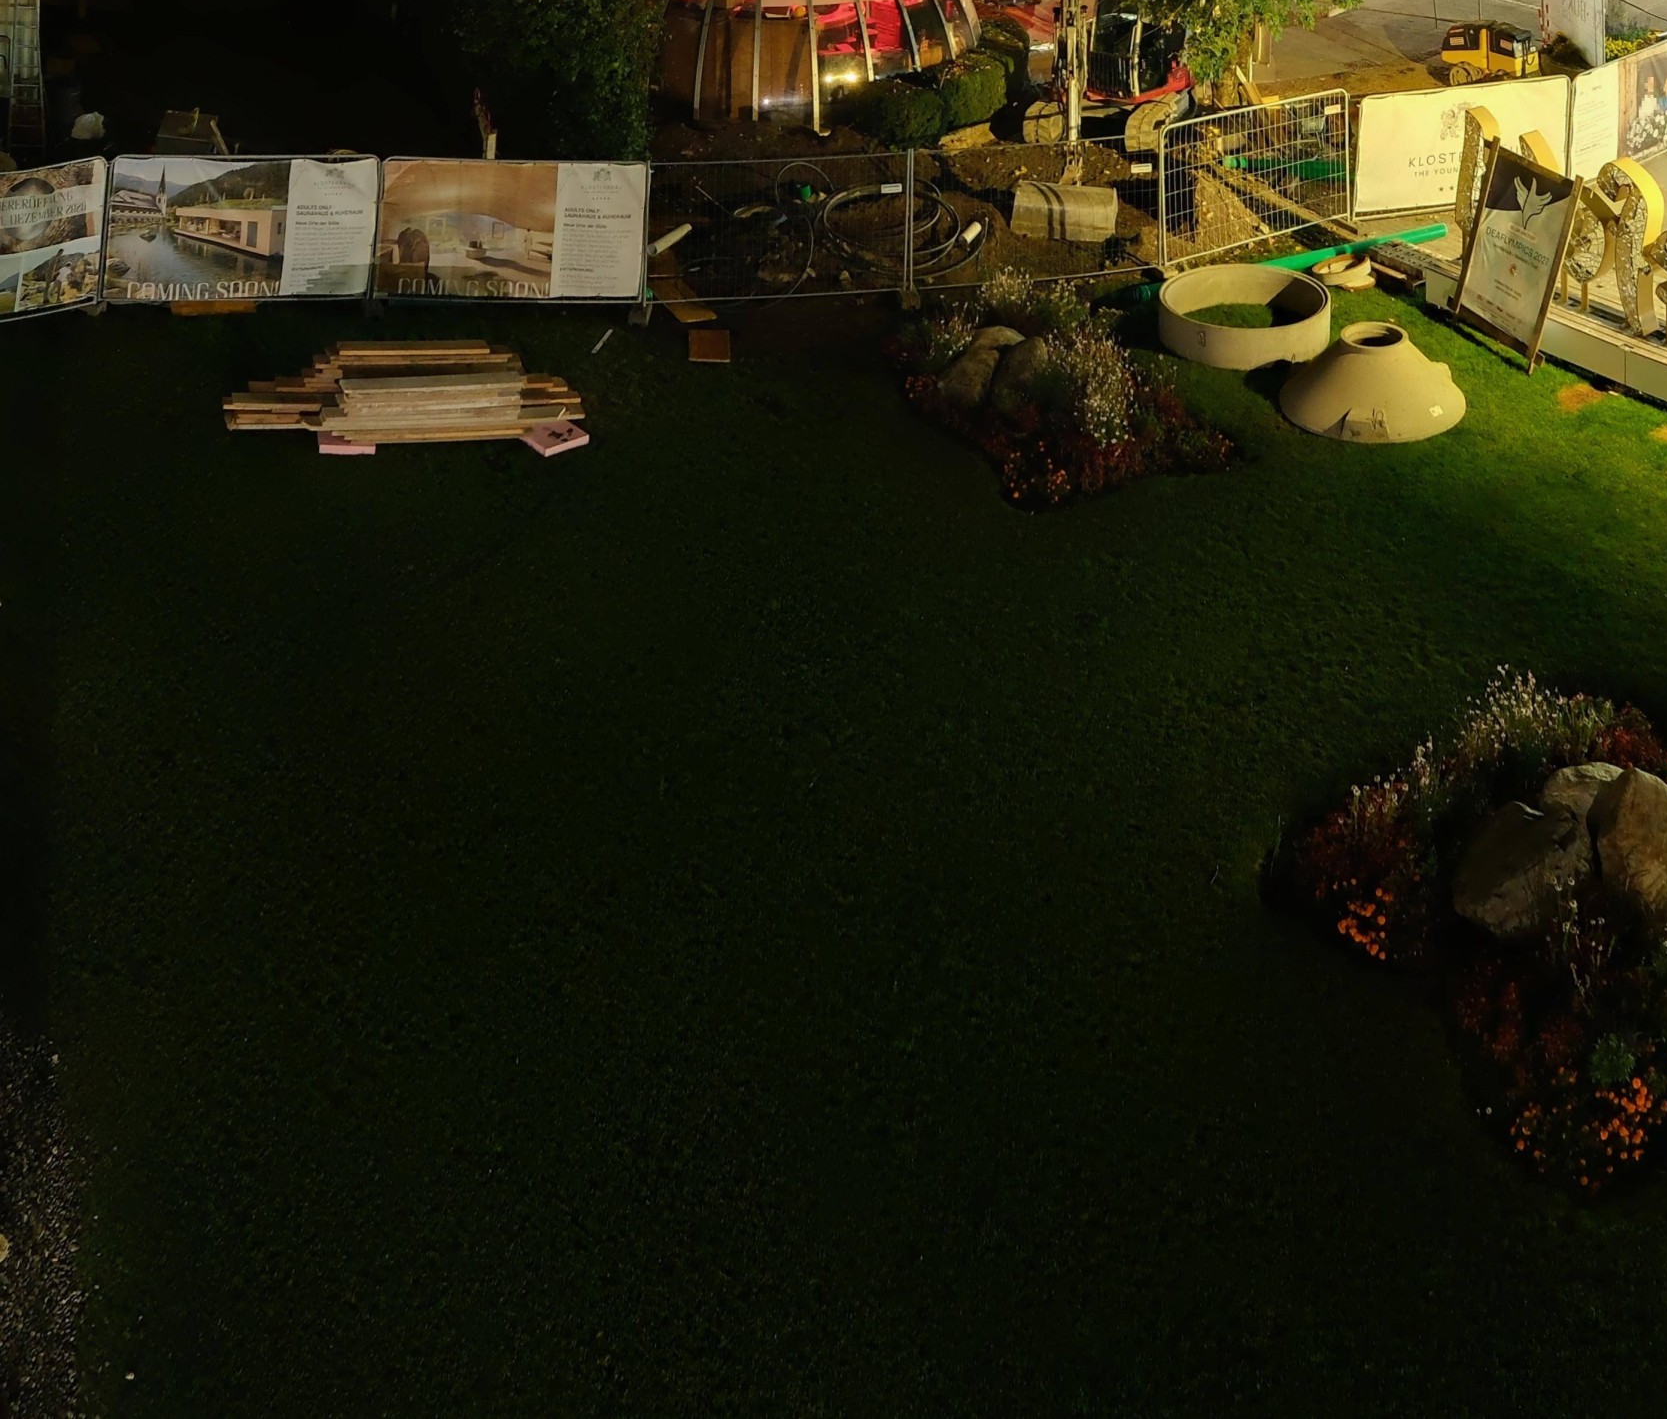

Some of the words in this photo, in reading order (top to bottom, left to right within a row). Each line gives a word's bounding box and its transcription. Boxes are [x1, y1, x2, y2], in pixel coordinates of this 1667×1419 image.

[1434, 167, 1459, 176] YOUN
[0, 190, 73, 212] ERERÖFFNUNG
[1486, 226, 1533, 258] DEAFLYMPICS
[1533, 252, 1550, 266] 2027
[127, 282, 209, 299] COMING
[398, 278, 478, 297] COMING
